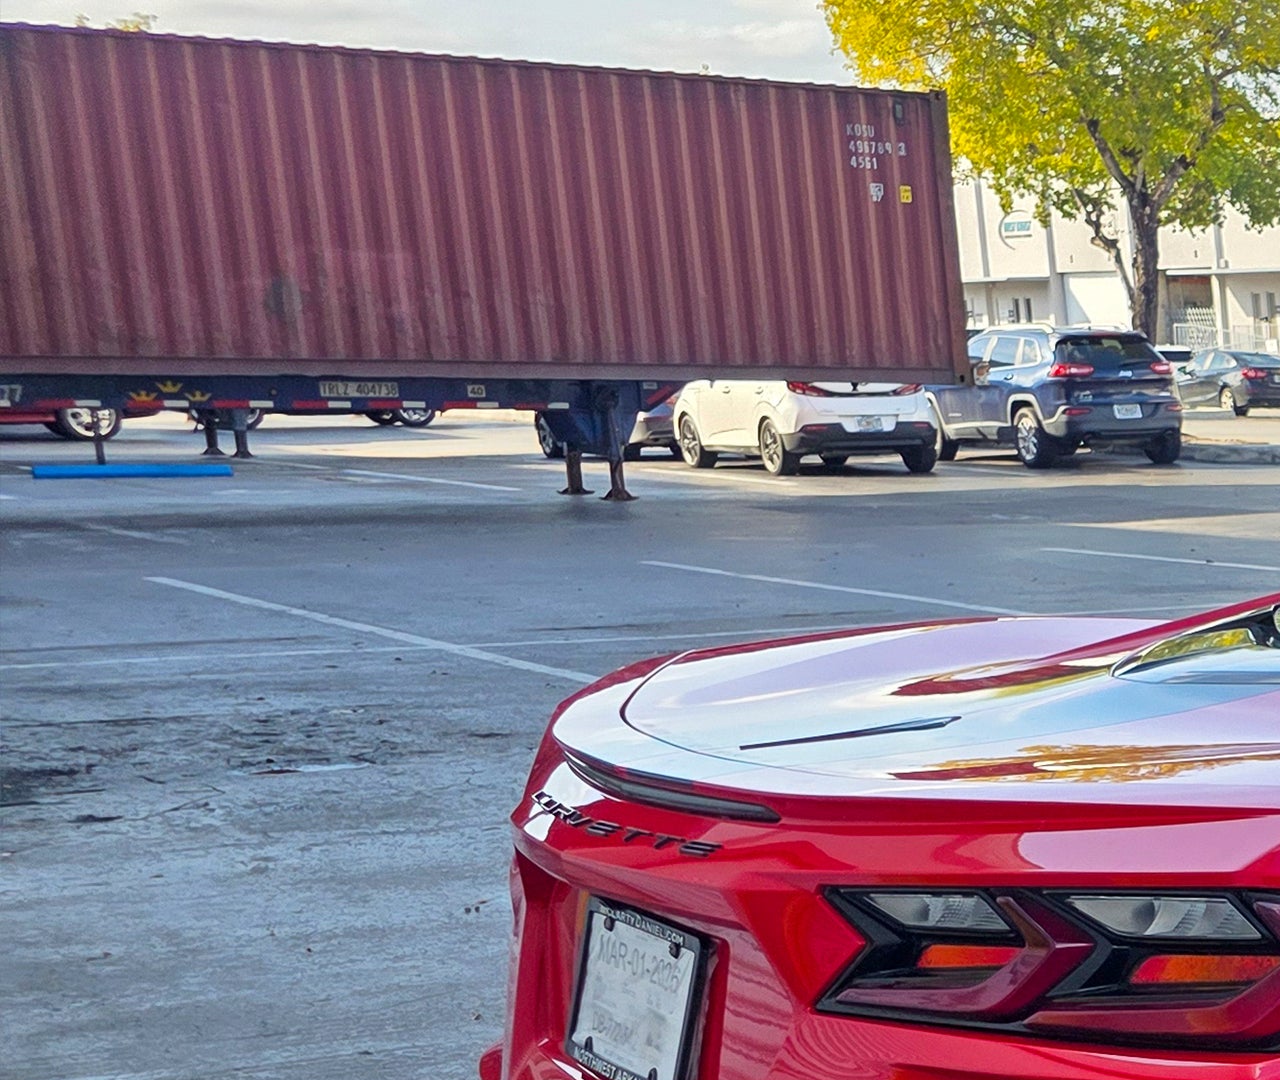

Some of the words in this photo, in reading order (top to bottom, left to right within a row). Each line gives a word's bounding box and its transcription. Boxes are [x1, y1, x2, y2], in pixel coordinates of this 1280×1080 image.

[846, 123, 875, 138] KOSU
[849, 140, 892, 154] 496789
[469, 385, 484, 396] 40
[531, 790, 724, 858] CORVETTE
[574, 1045, 617, 1080] NORTHWEST
